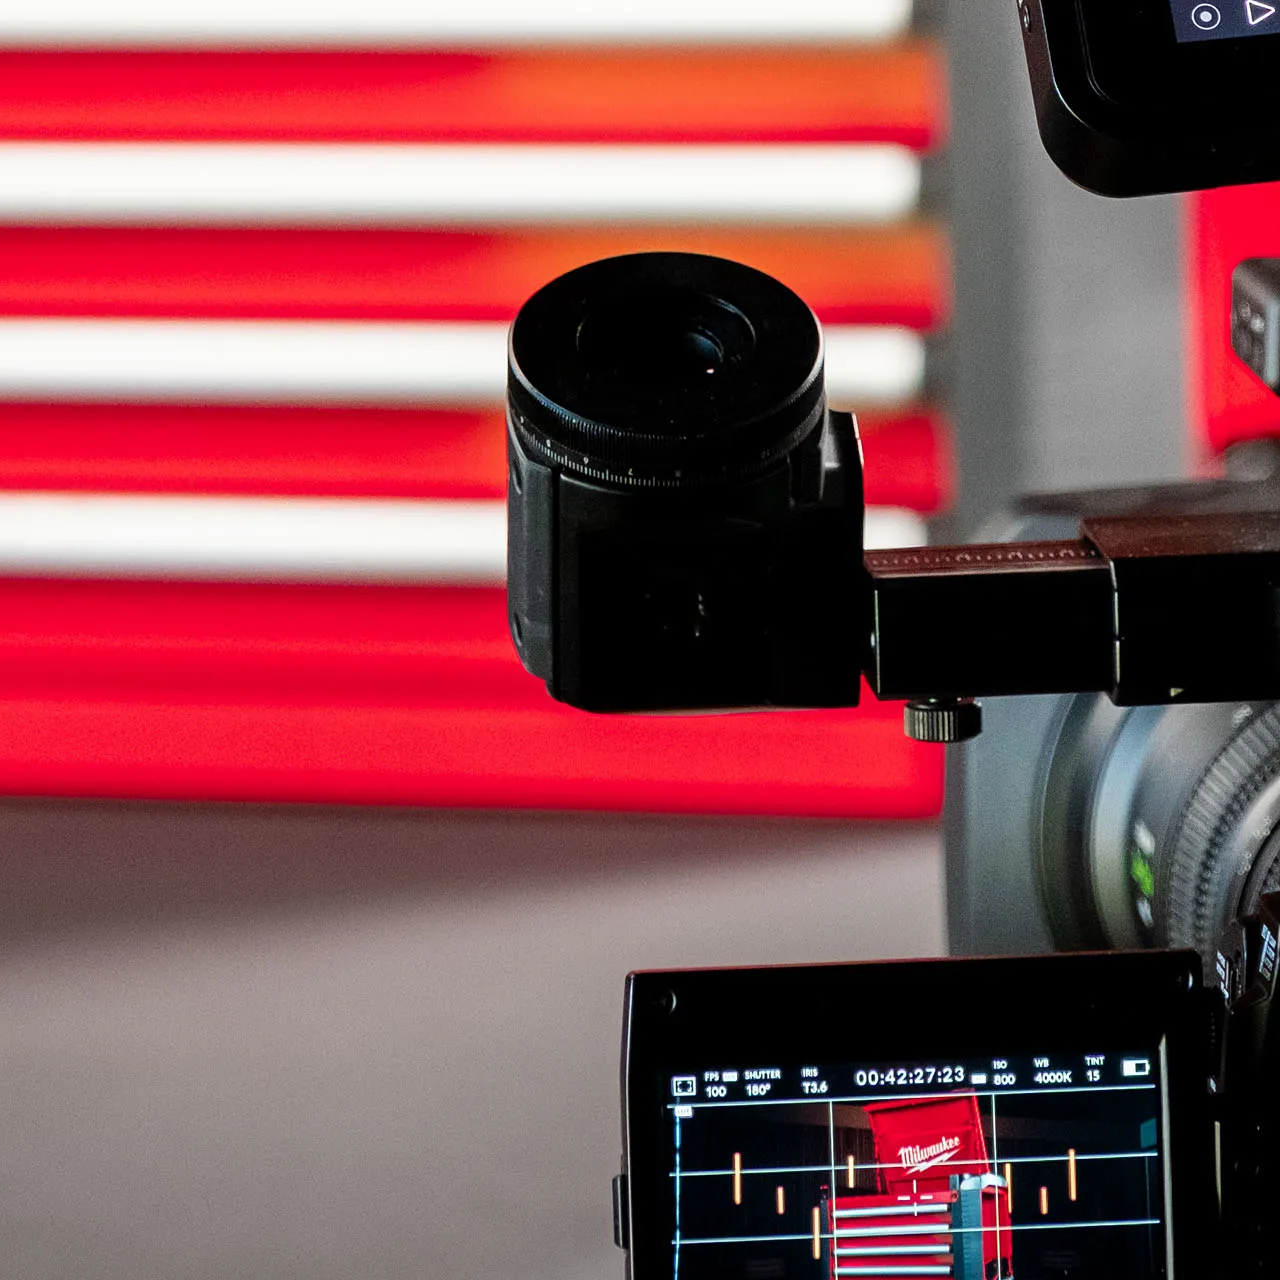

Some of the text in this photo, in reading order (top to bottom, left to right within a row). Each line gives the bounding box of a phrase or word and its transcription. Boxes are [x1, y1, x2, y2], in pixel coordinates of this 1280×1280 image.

[993, 1060, 1008, 1070] ISO
[1034, 1057, 1050, 1068] WB
[1085, 1055, 1105, 1067] TINT
[703, 1071, 720, 1082] FPS
[744, 1068, 782, 1081] SHUTTER
[801, 1066, 818, 1078] IRIS
[855, 1066, 965, 1086] 00:42:27:23
[1033, 1071, 1073, 1084] 4000K
[1086, 1070, 1101, 1082] 15
[993, 1074, 1016, 1086] 800
[705, 1085, 727, 1098] 100
[801, 1081, 829, 1094] T3.6
[897, 1136, 961, 1169] Milwaukee
